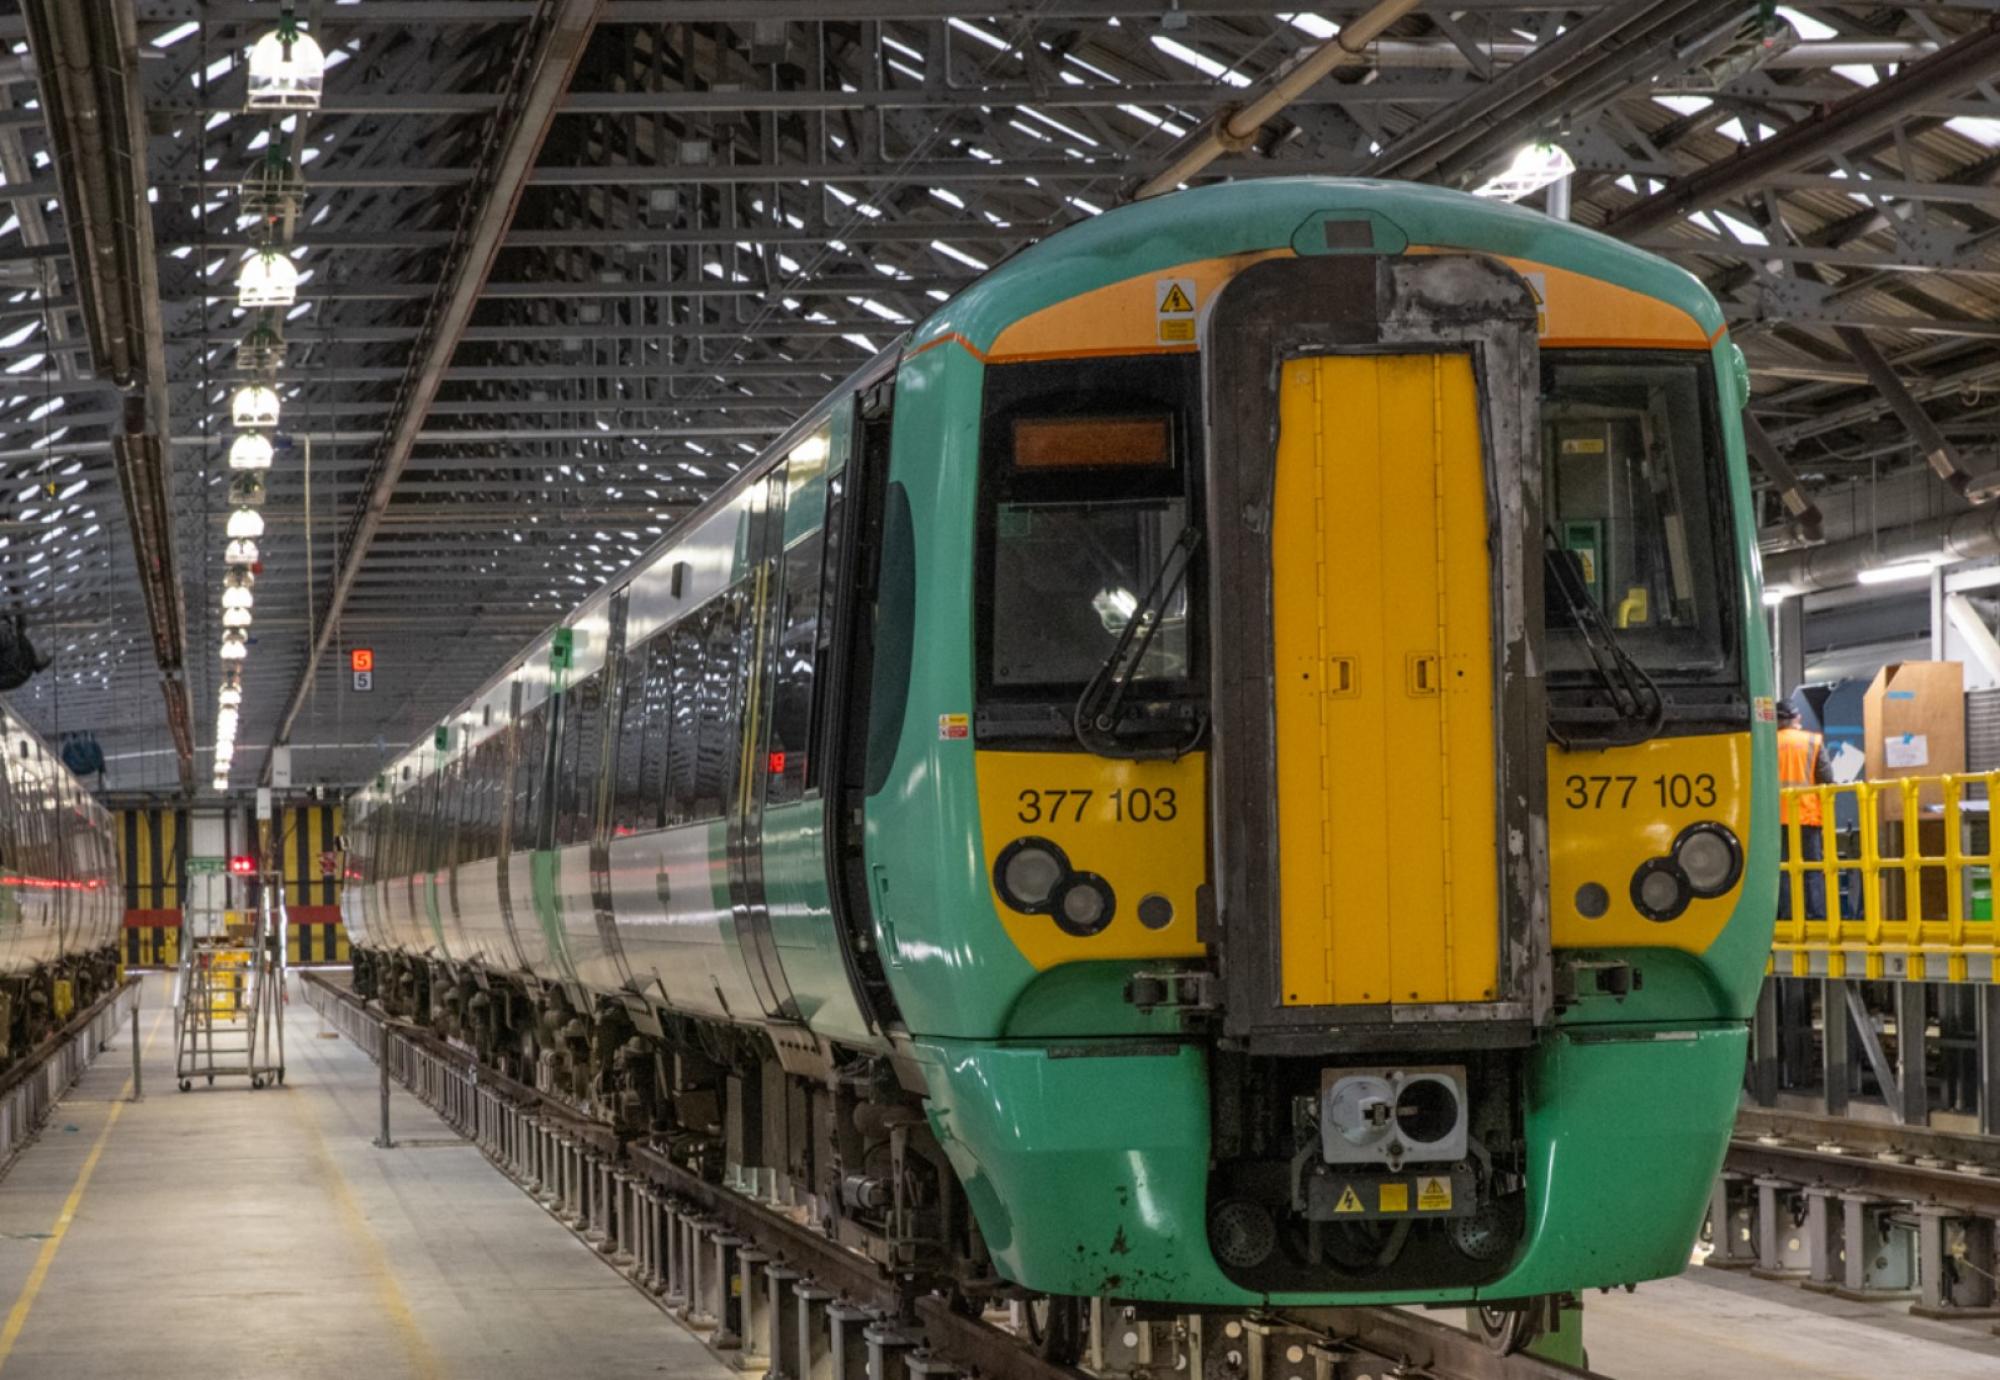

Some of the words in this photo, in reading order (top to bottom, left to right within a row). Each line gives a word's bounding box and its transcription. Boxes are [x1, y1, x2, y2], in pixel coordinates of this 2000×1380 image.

[357, 654, 367, 667] 5
[358, 673, 368, 687] 5
[1566, 774, 1637, 809] 377
[1654, 773, 1717, 808] 103
[1018, 788, 1093, 823] 377
[1109, 787, 1177, 822] 103
